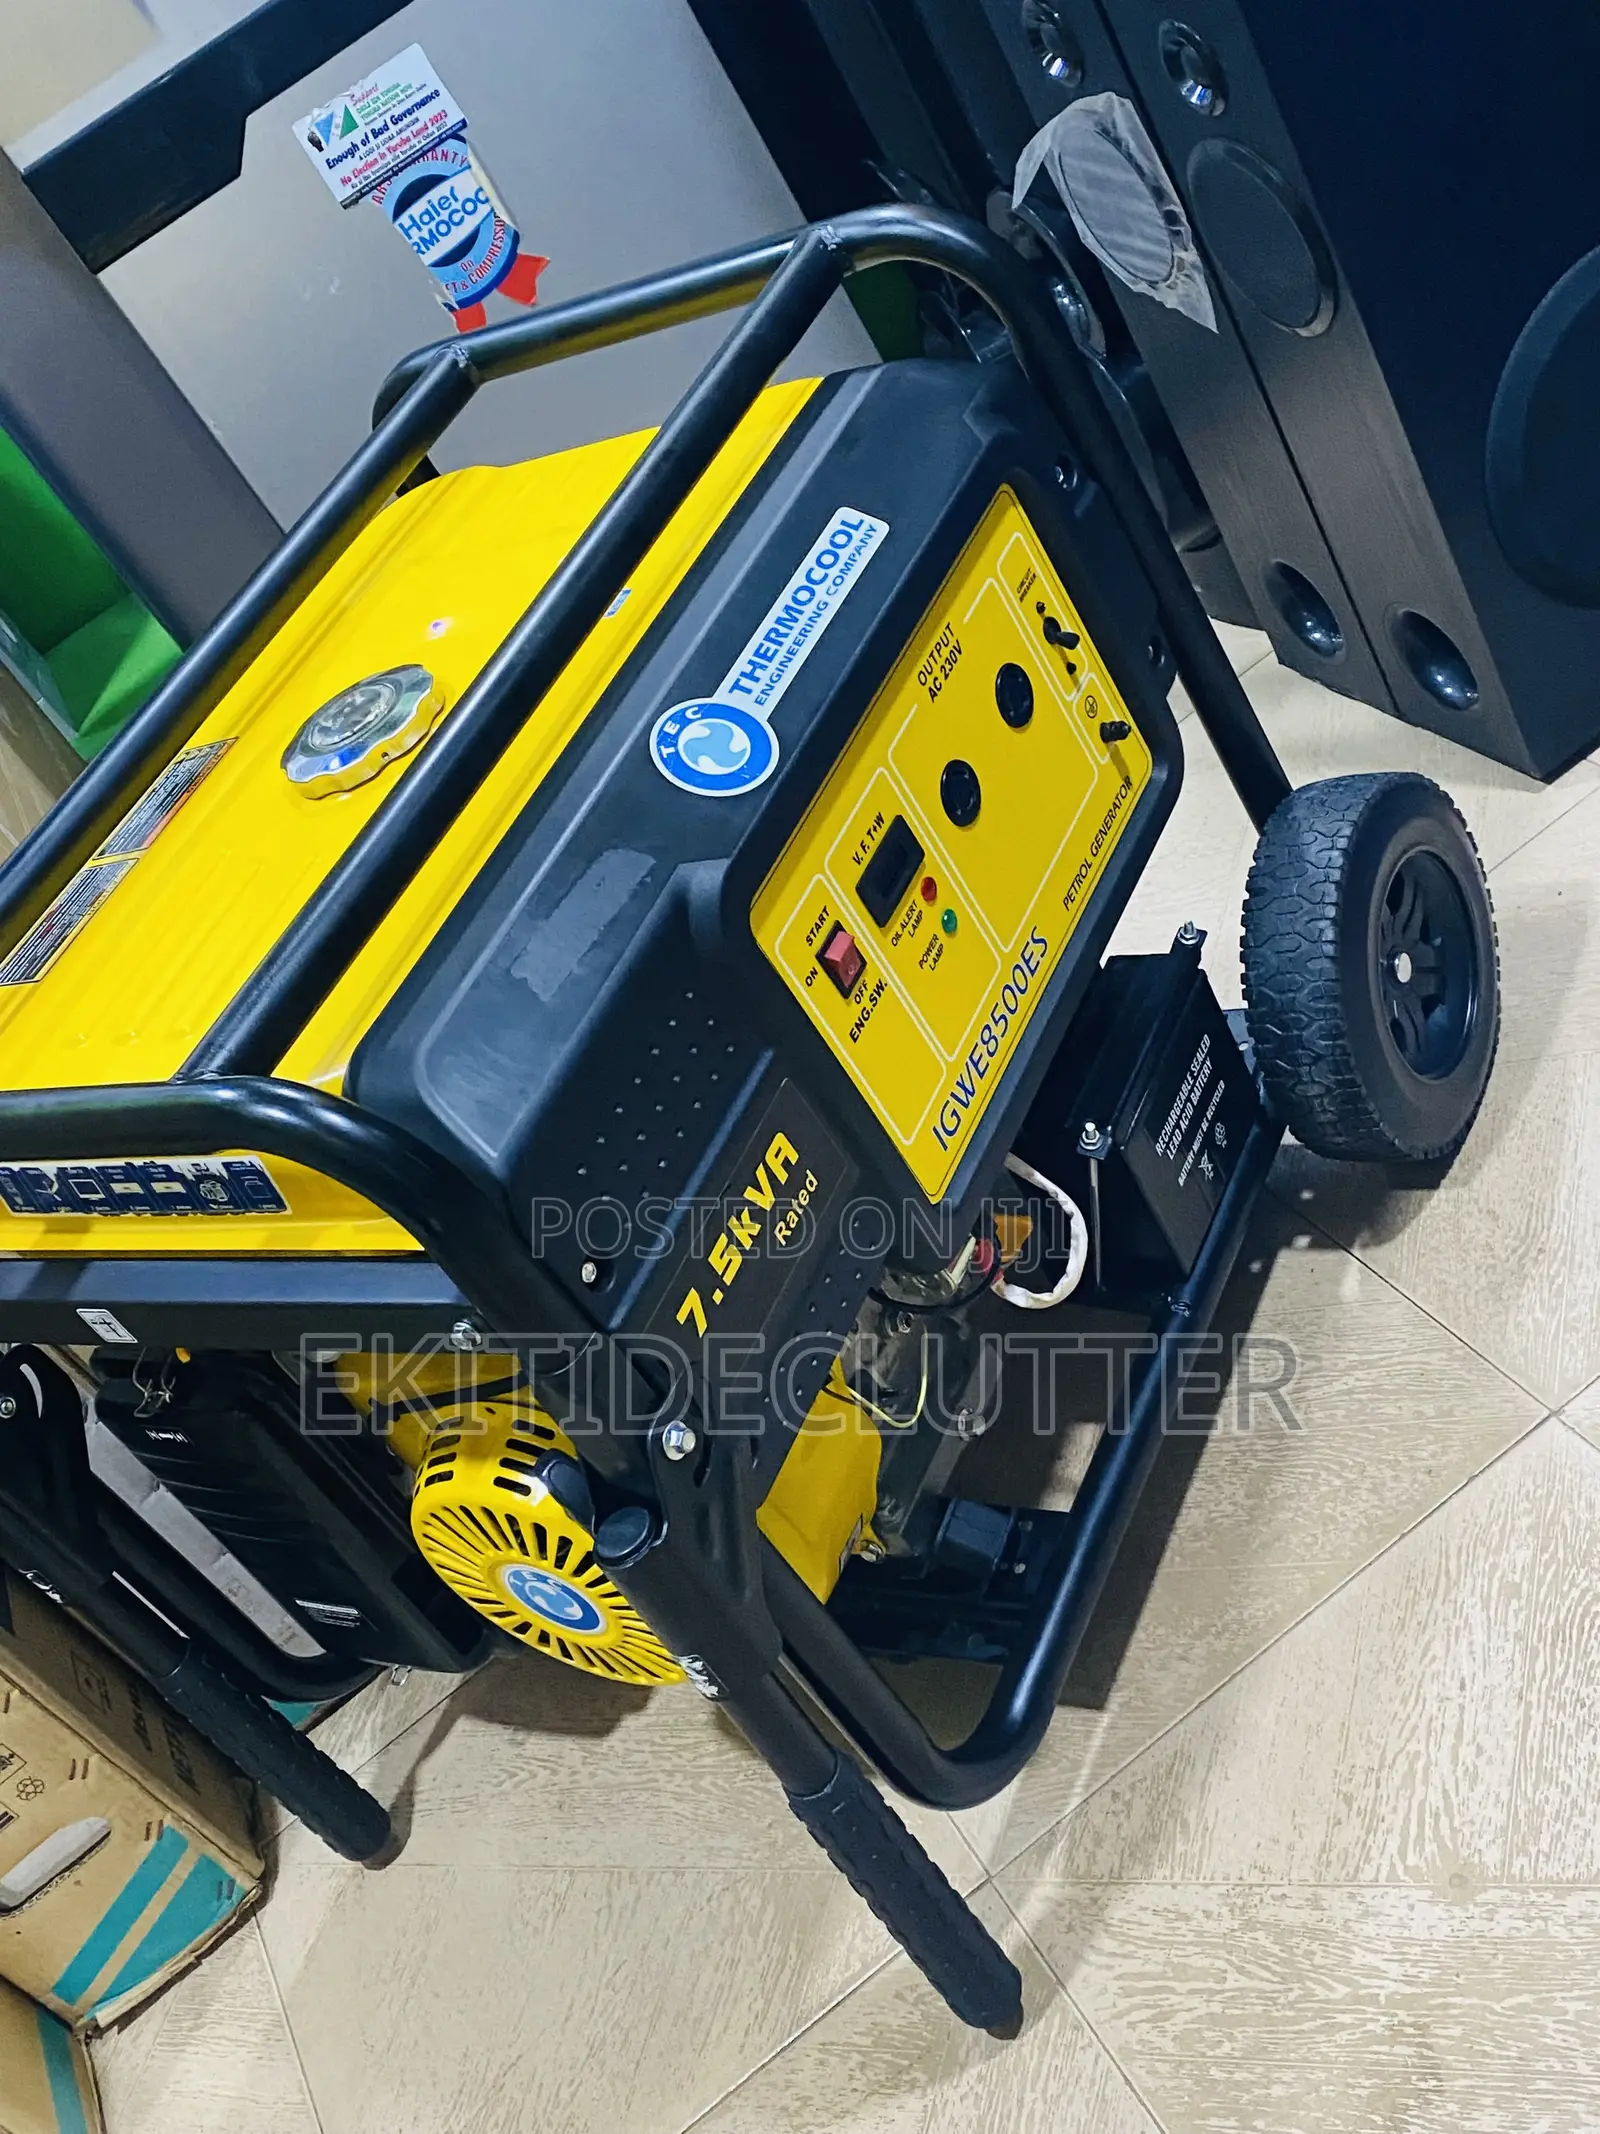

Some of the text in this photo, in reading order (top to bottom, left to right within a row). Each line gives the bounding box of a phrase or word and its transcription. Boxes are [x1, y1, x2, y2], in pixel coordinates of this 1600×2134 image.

[326, 140, 360, 169] Enough
[359, 133, 371, 147] of
[371, 120, 390, 139] Bad
[391, 88, 440, 125] Governance
[341, 174, 352, 186] No
[352, 155, 379, 178] Election
[387, 133, 411, 154] Yoruba
[412, 121, 429, 138] Land
[429, 109, 448, 127] 2023
[398, 186, 459, 240] Haier
[728, 518, 864, 696] THERMOCOOL
[754, 523, 878, 706] ENGINEERING COMPANY
[917, 622, 955, 687] OUTPUT
[928, 640, 964, 703] AC 230V
[660, 705, 703, 759] TEC
[1063, 775, 1133, 912] PETROL GENERATOR
[805, 905, 830, 947] START
[899, 900, 918, 934] ALERT
[908, 910, 923, 938] LAMP
[805, 967, 818, 988] ON
[919, 934, 940, 969] POWER
[929, 943, 944, 971] LAMP
[854, 980, 869, 1006] OFF
[931, 925, 1049, 1152] IGWE8500ES
[1155, 1033, 1211, 1157] RECHARGEABLE SEALED
[1166, 1056, 1213, 1160] LEAD ACID BATTERY
[1178, 1148, 1195, 1187] BATTERY
[1201, 1117, 1209, 1132] BE
[774, 1169, 819, 1246] Rated
